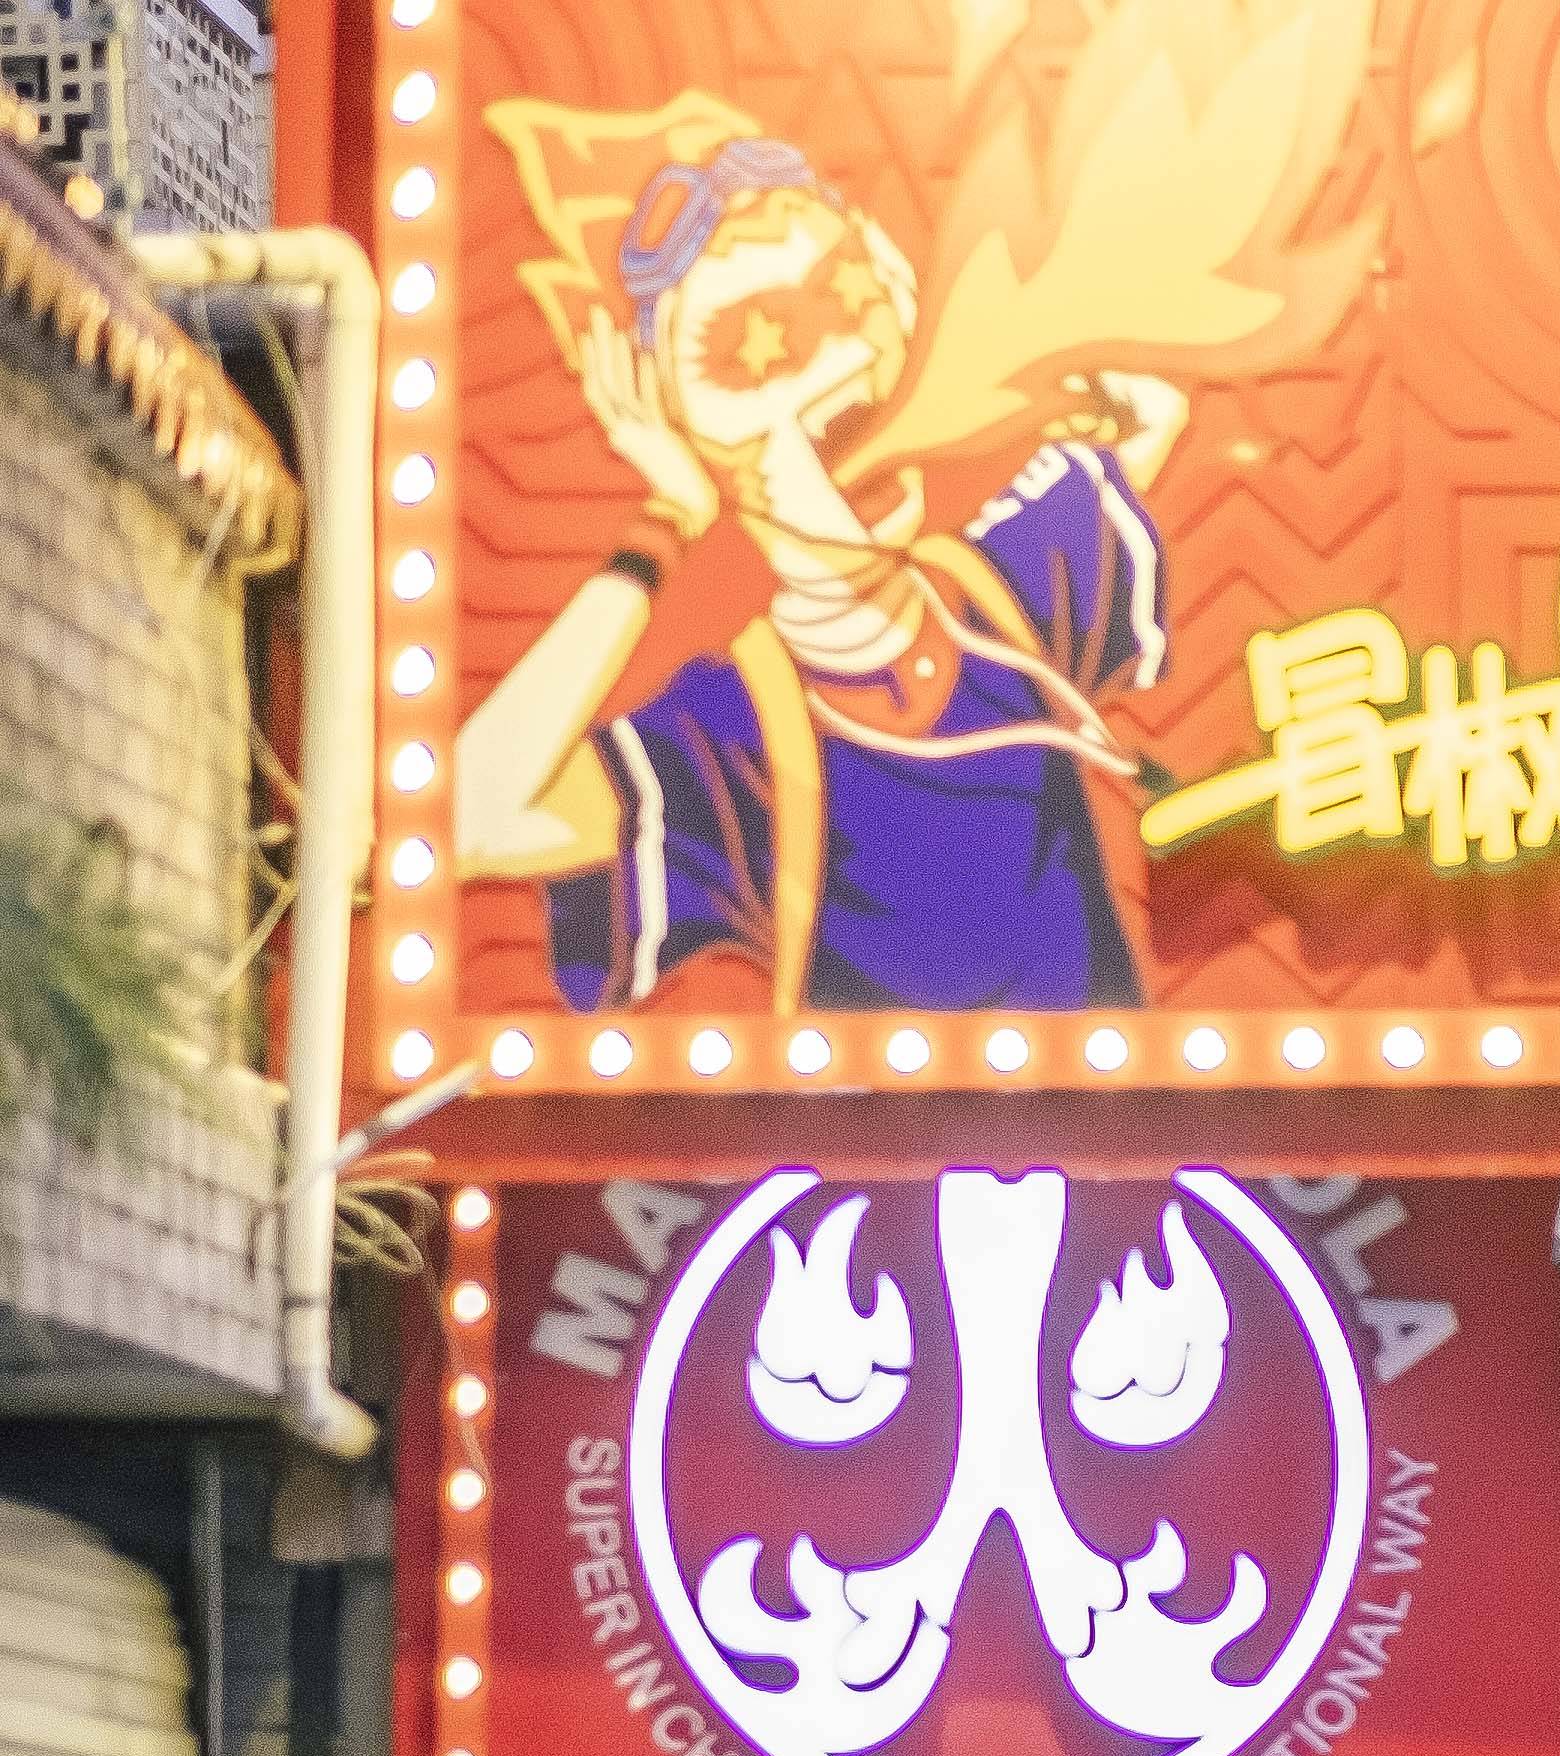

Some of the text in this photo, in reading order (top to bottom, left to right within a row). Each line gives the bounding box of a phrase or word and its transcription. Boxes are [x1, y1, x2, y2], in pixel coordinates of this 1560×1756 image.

[566, 1437, 636, 1645] SUPER
[607, 1643, 675, 1715] IN
[1372, 1449, 1438, 1575] WAY
